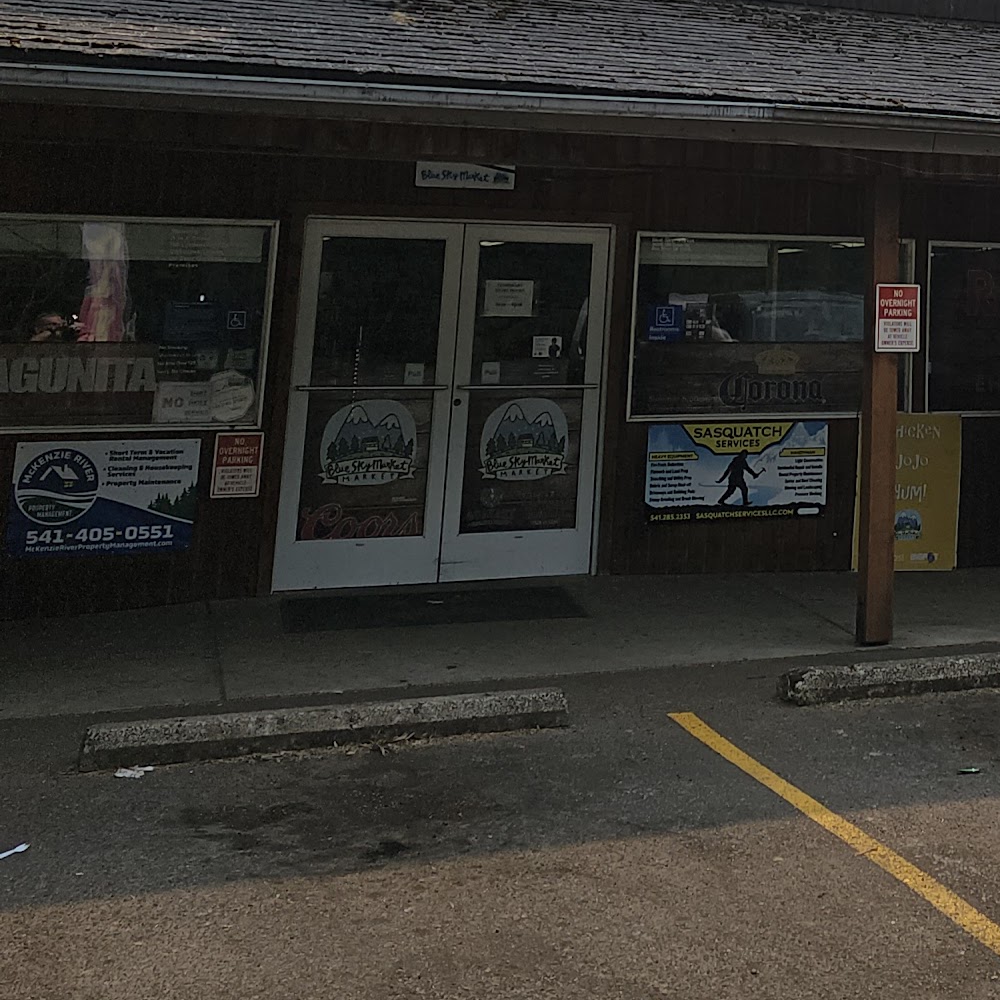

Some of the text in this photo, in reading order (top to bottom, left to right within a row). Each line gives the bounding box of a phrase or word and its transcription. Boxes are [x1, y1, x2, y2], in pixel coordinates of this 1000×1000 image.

[421, 169, 440, 181] Blue
[893, 289, 904, 298] NO
[880, 299, 917, 308] OVERNIGHT
[883, 308, 913, 317] PARKING
[718, 370, 824, 409] Corona
[162, 397, 184, 408] NO
[693, 426, 783, 439] SASQUATCH
[234, 437, 246, 446] NO
[715, 439, 761, 448] SERVICES
[219, 446, 259, 456] OVERNIGHT
[222, 455, 255, 465] PARKING
[22, 450, 96, 485] McKENZIE RIVER
[500, 468, 548, 477] MARKET
[342, 473, 394, 482] MARKET
[894, 484, 928, 502] YUM!
[299, 502, 419, 540] Coors
[25, 524, 175, 545] 541-405-0551
[25, 539, 173, 553] McKenzieRiverPropertyManagement.com
